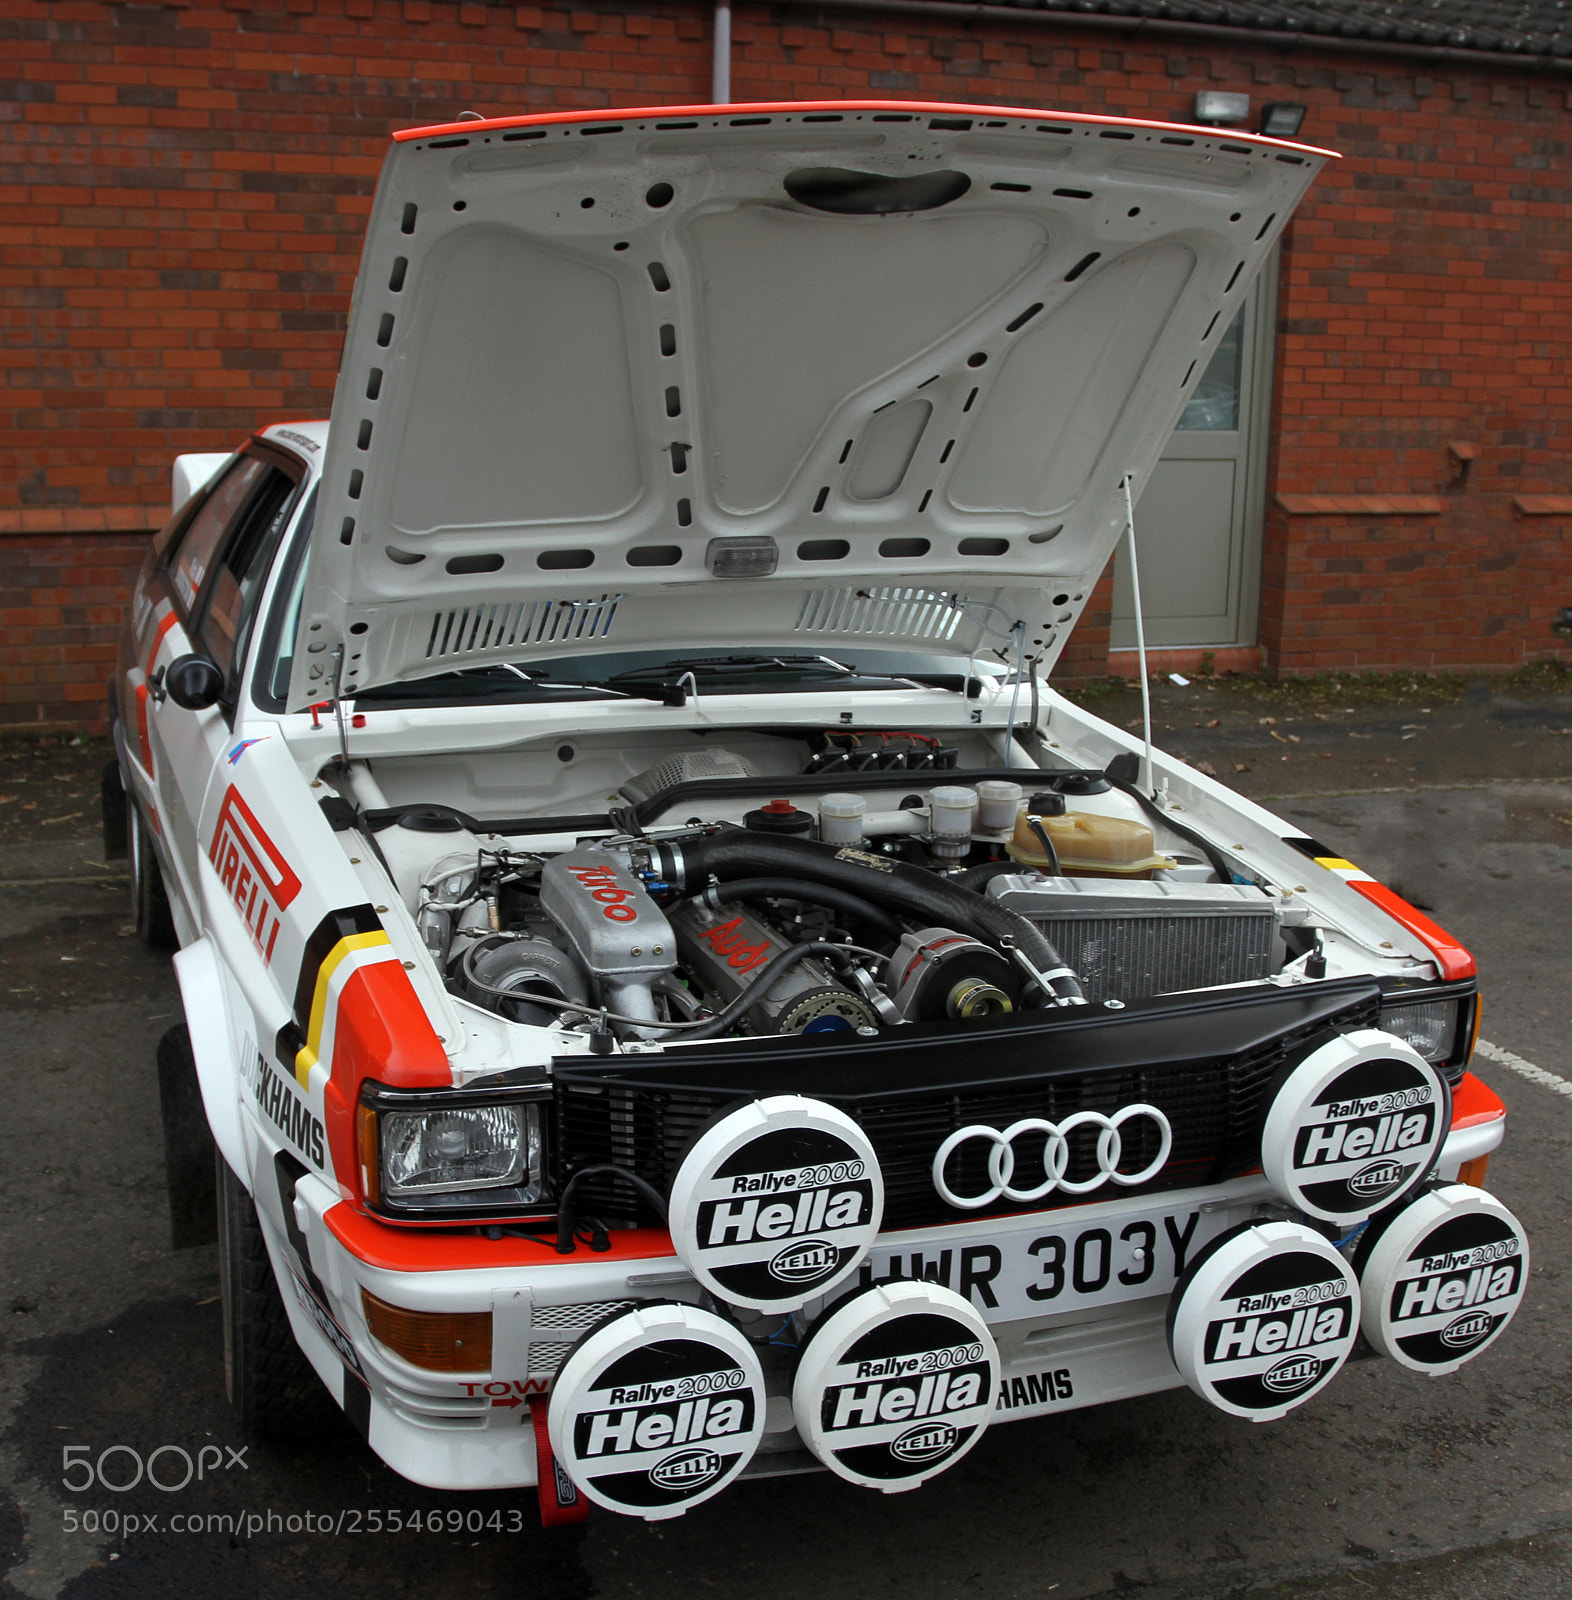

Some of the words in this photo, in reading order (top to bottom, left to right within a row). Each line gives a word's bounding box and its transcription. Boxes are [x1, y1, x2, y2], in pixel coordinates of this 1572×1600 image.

[208, 782, 302, 970] PIRELLI
[568, 865, 638, 925] Turbo
[698, 916, 772, 975] Audi
[240, 1029, 325, 1171] DUCKHAMS
[1326, 1099, 1378, 1119] Rallye
[1379, 1086, 1432, 1114] 2000
[1302, 1113, 1428, 1165] Hella
[732, 1172, 796, 1194] Rallye
[798, 1160, 865, 1189] 2000
[1352, 1164, 1403, 1186] HELLA
[708, 1188, 863, 1245] Hella
[775, 1246, 838, 1269] HELLA
[1025, 1212, 1200, 1302] 303Y
[1421, 1252, 1470, 1273] Rallye
[1470, 1238, 1519, 1267] 2000
[1237, 1294, 1291, 1313] Rallye
[1292, 1279, 1347, 1308] 2000
[1398, 1265, 1515, 1318] Hella
[1213, 1306, 1344, 1360] Hella
[1445, 1314, 1492, 1337] HELLA
[857, 1358, 918, 1378] Rallye
[920, 1343, 984, 1373] 2000
[1267, 1359, 1321, 1381] HELLA
[458, 1379, 548, 1397] TOW
[609, 1384, 675, 1405] Rallye
[676, 1369, 745, 1398] 2000
[832, 1372, 981, 1428] Hella
[586, 1398, 744, 1455] Hella
[896, 1427, 957, 1450] HELLA
[656, 1453, 720, 1477] HELLA
